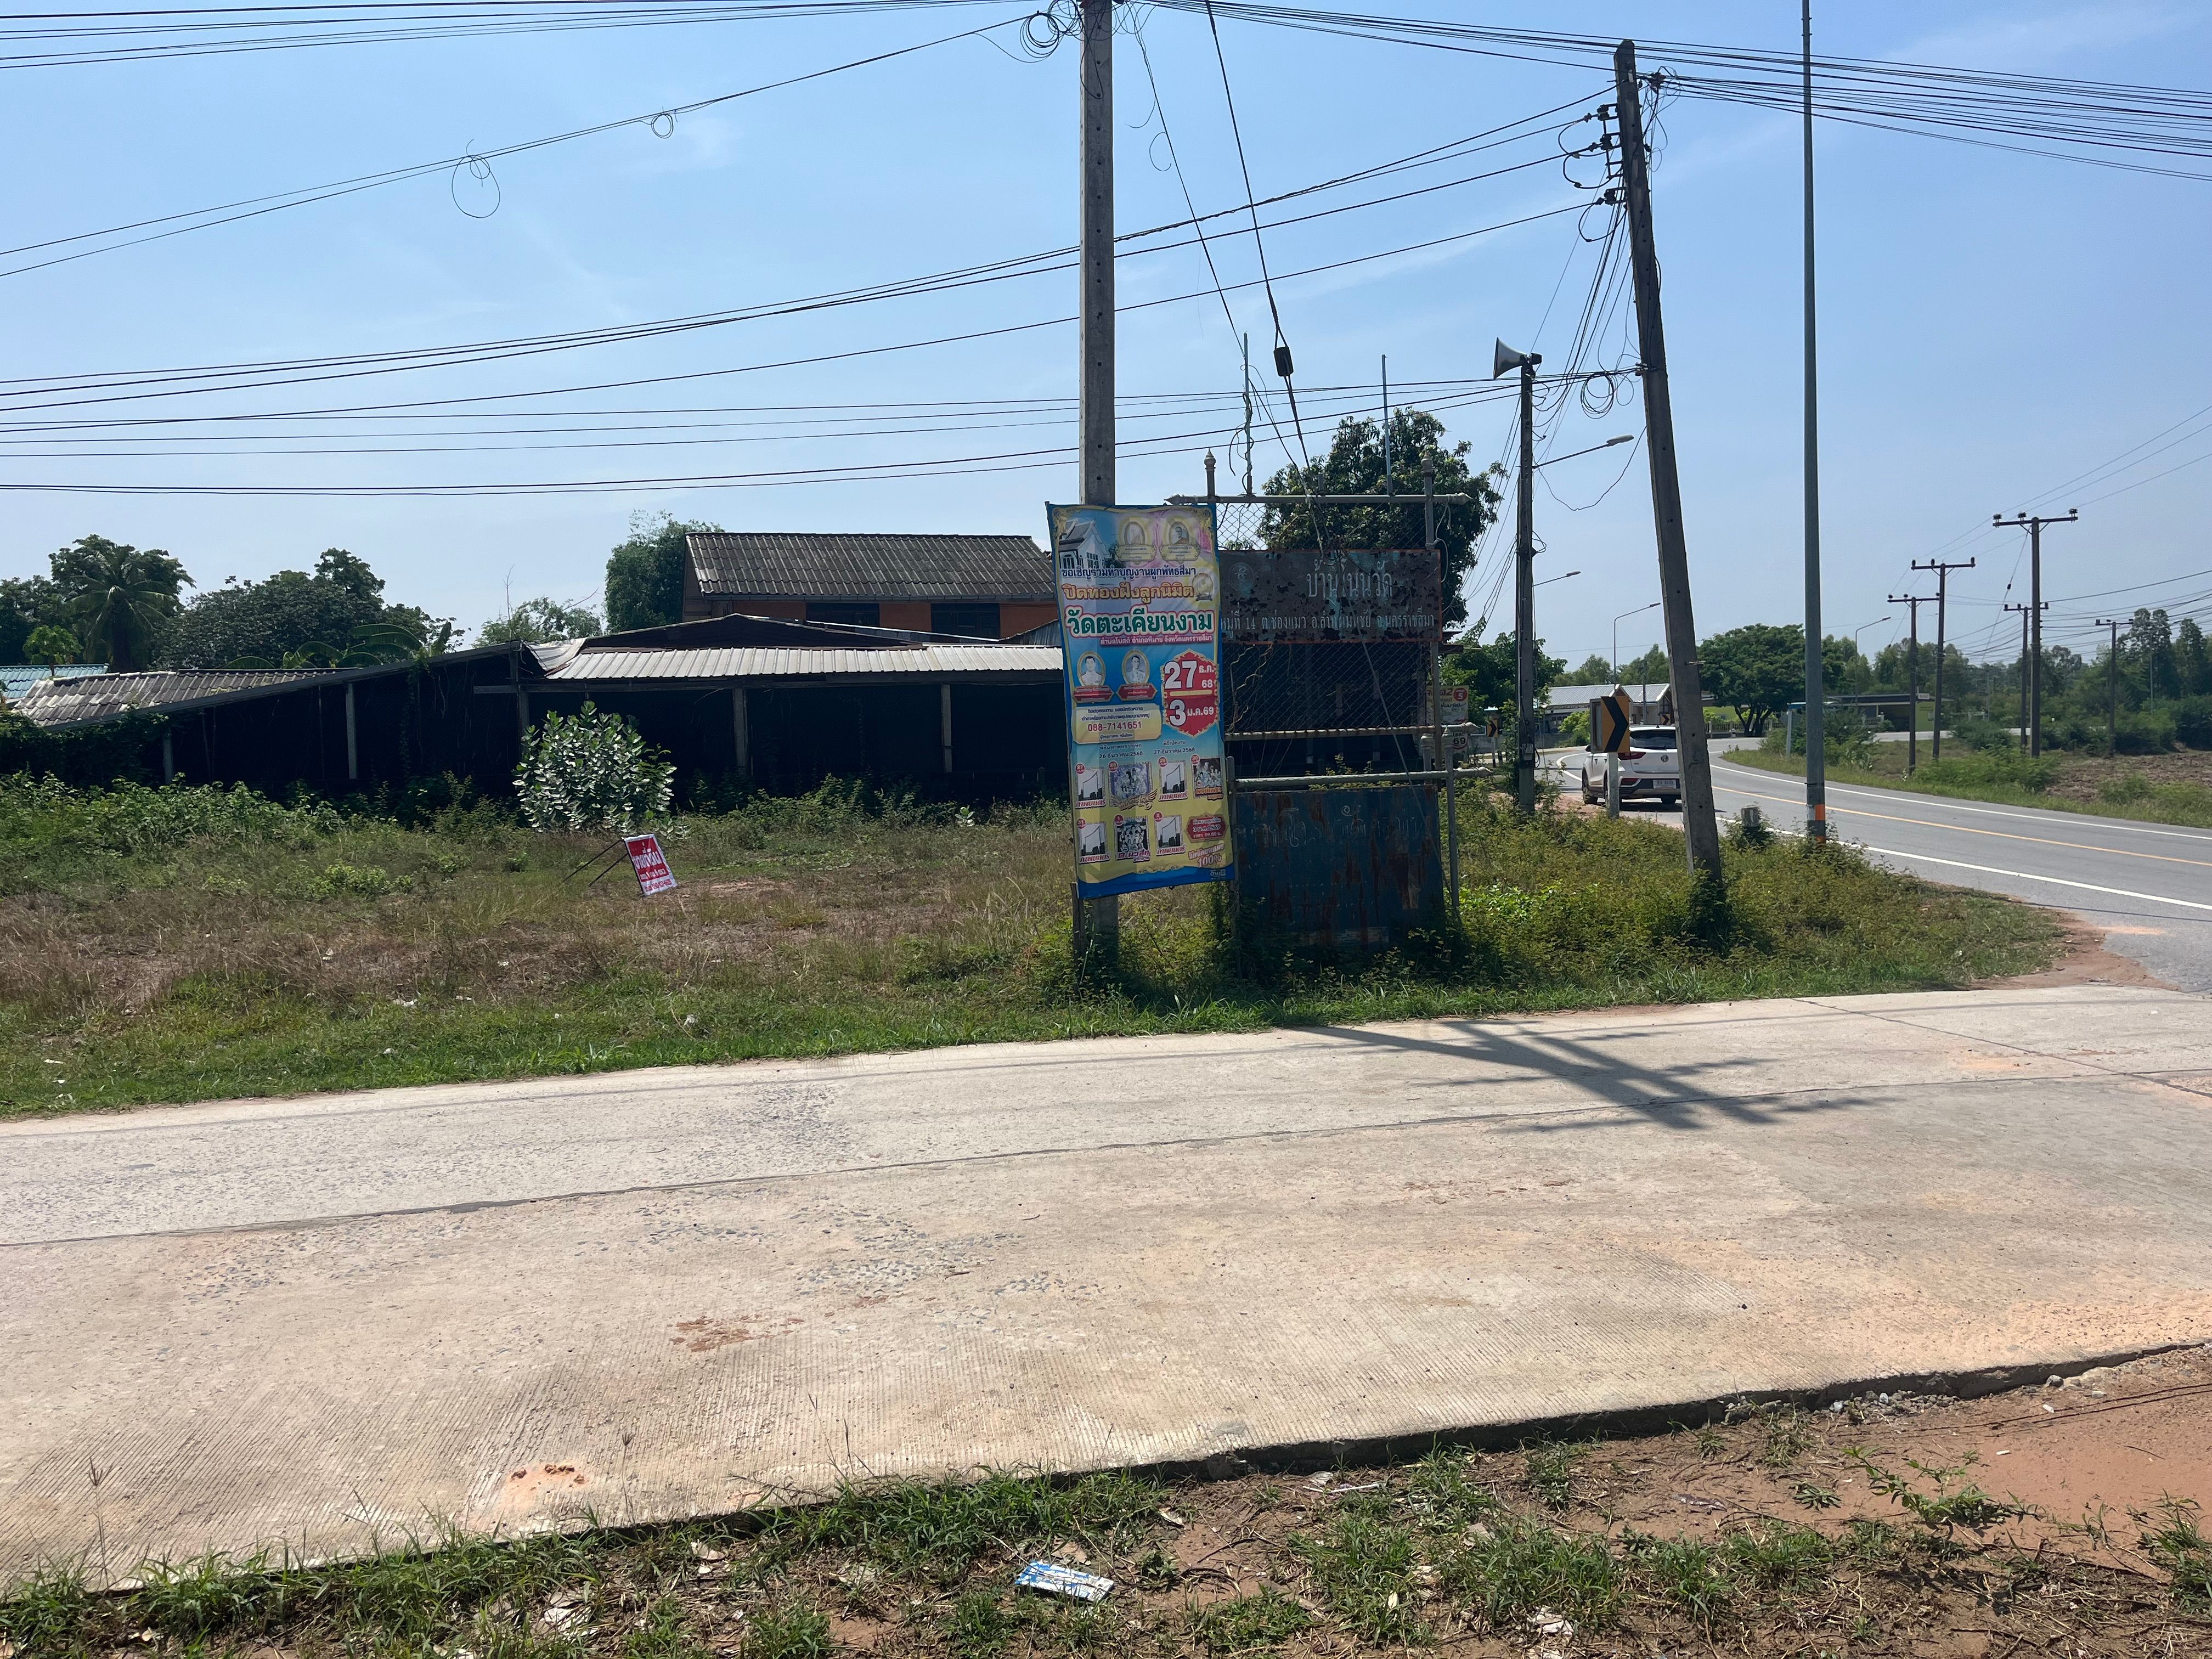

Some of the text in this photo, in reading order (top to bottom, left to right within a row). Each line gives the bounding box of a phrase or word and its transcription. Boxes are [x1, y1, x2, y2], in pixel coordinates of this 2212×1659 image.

[1062, 565, 1196, 580] ขอเชิญร่วมทำบุญงานผูกพัทธสีมา
[1063, 582, 1194, 603] ปิดทองฝังลูกนิมิต
[1067, 608, 1212, 634] วัดตะเคียนงาม
[1246, 617, 1256, 630] 14
[1164, 661, 1214, 689] 27 ธ.ค. 68
[1169, 699, 1214, 726] 3 ม.ค.69
[1088, 721, 1142, 731] 088-7141651
